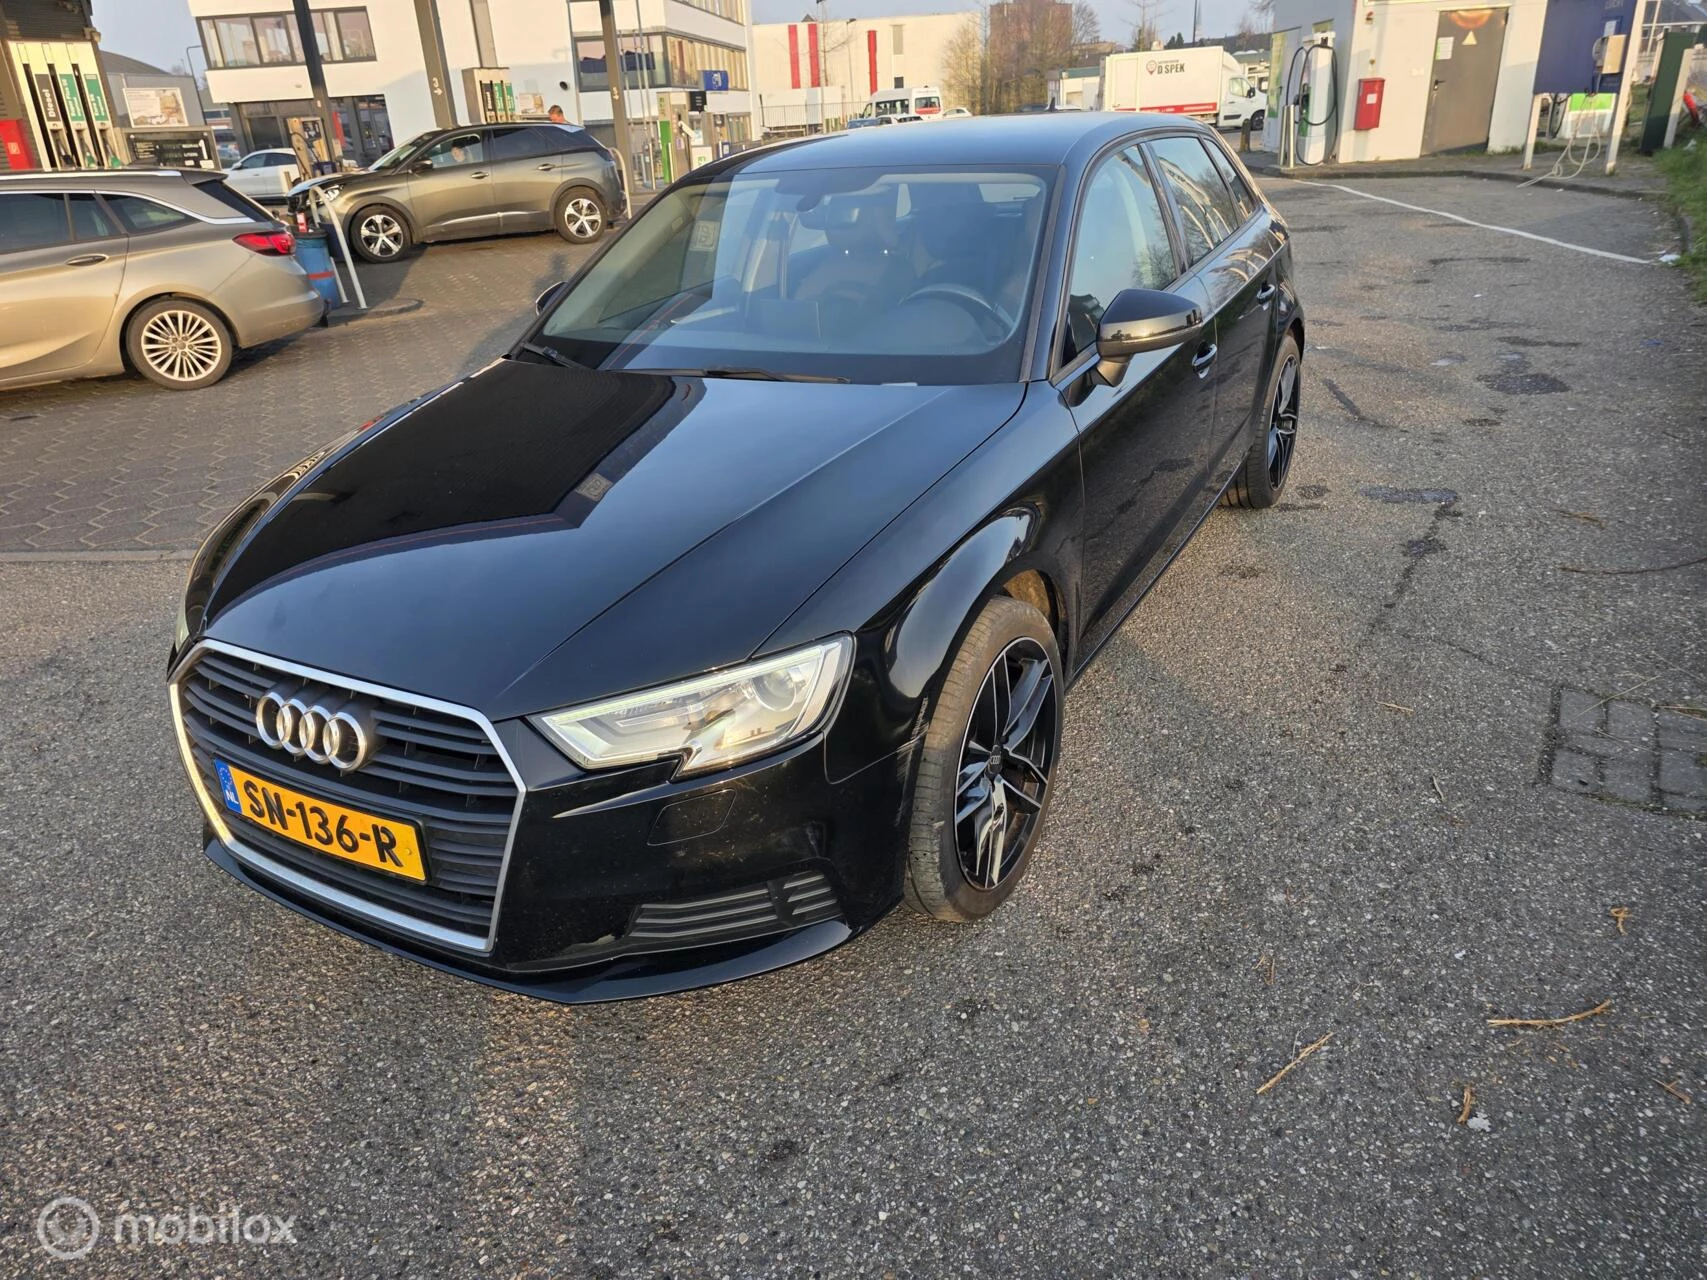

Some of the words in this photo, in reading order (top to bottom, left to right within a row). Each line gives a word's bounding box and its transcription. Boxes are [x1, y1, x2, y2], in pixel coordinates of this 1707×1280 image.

[1164, 63, 1185, 74] SPEK
[42, 89, 56, 118] Diesel
[225, 790, 239, 805] NL
[243, 780, 404, 868] SN-136-R
